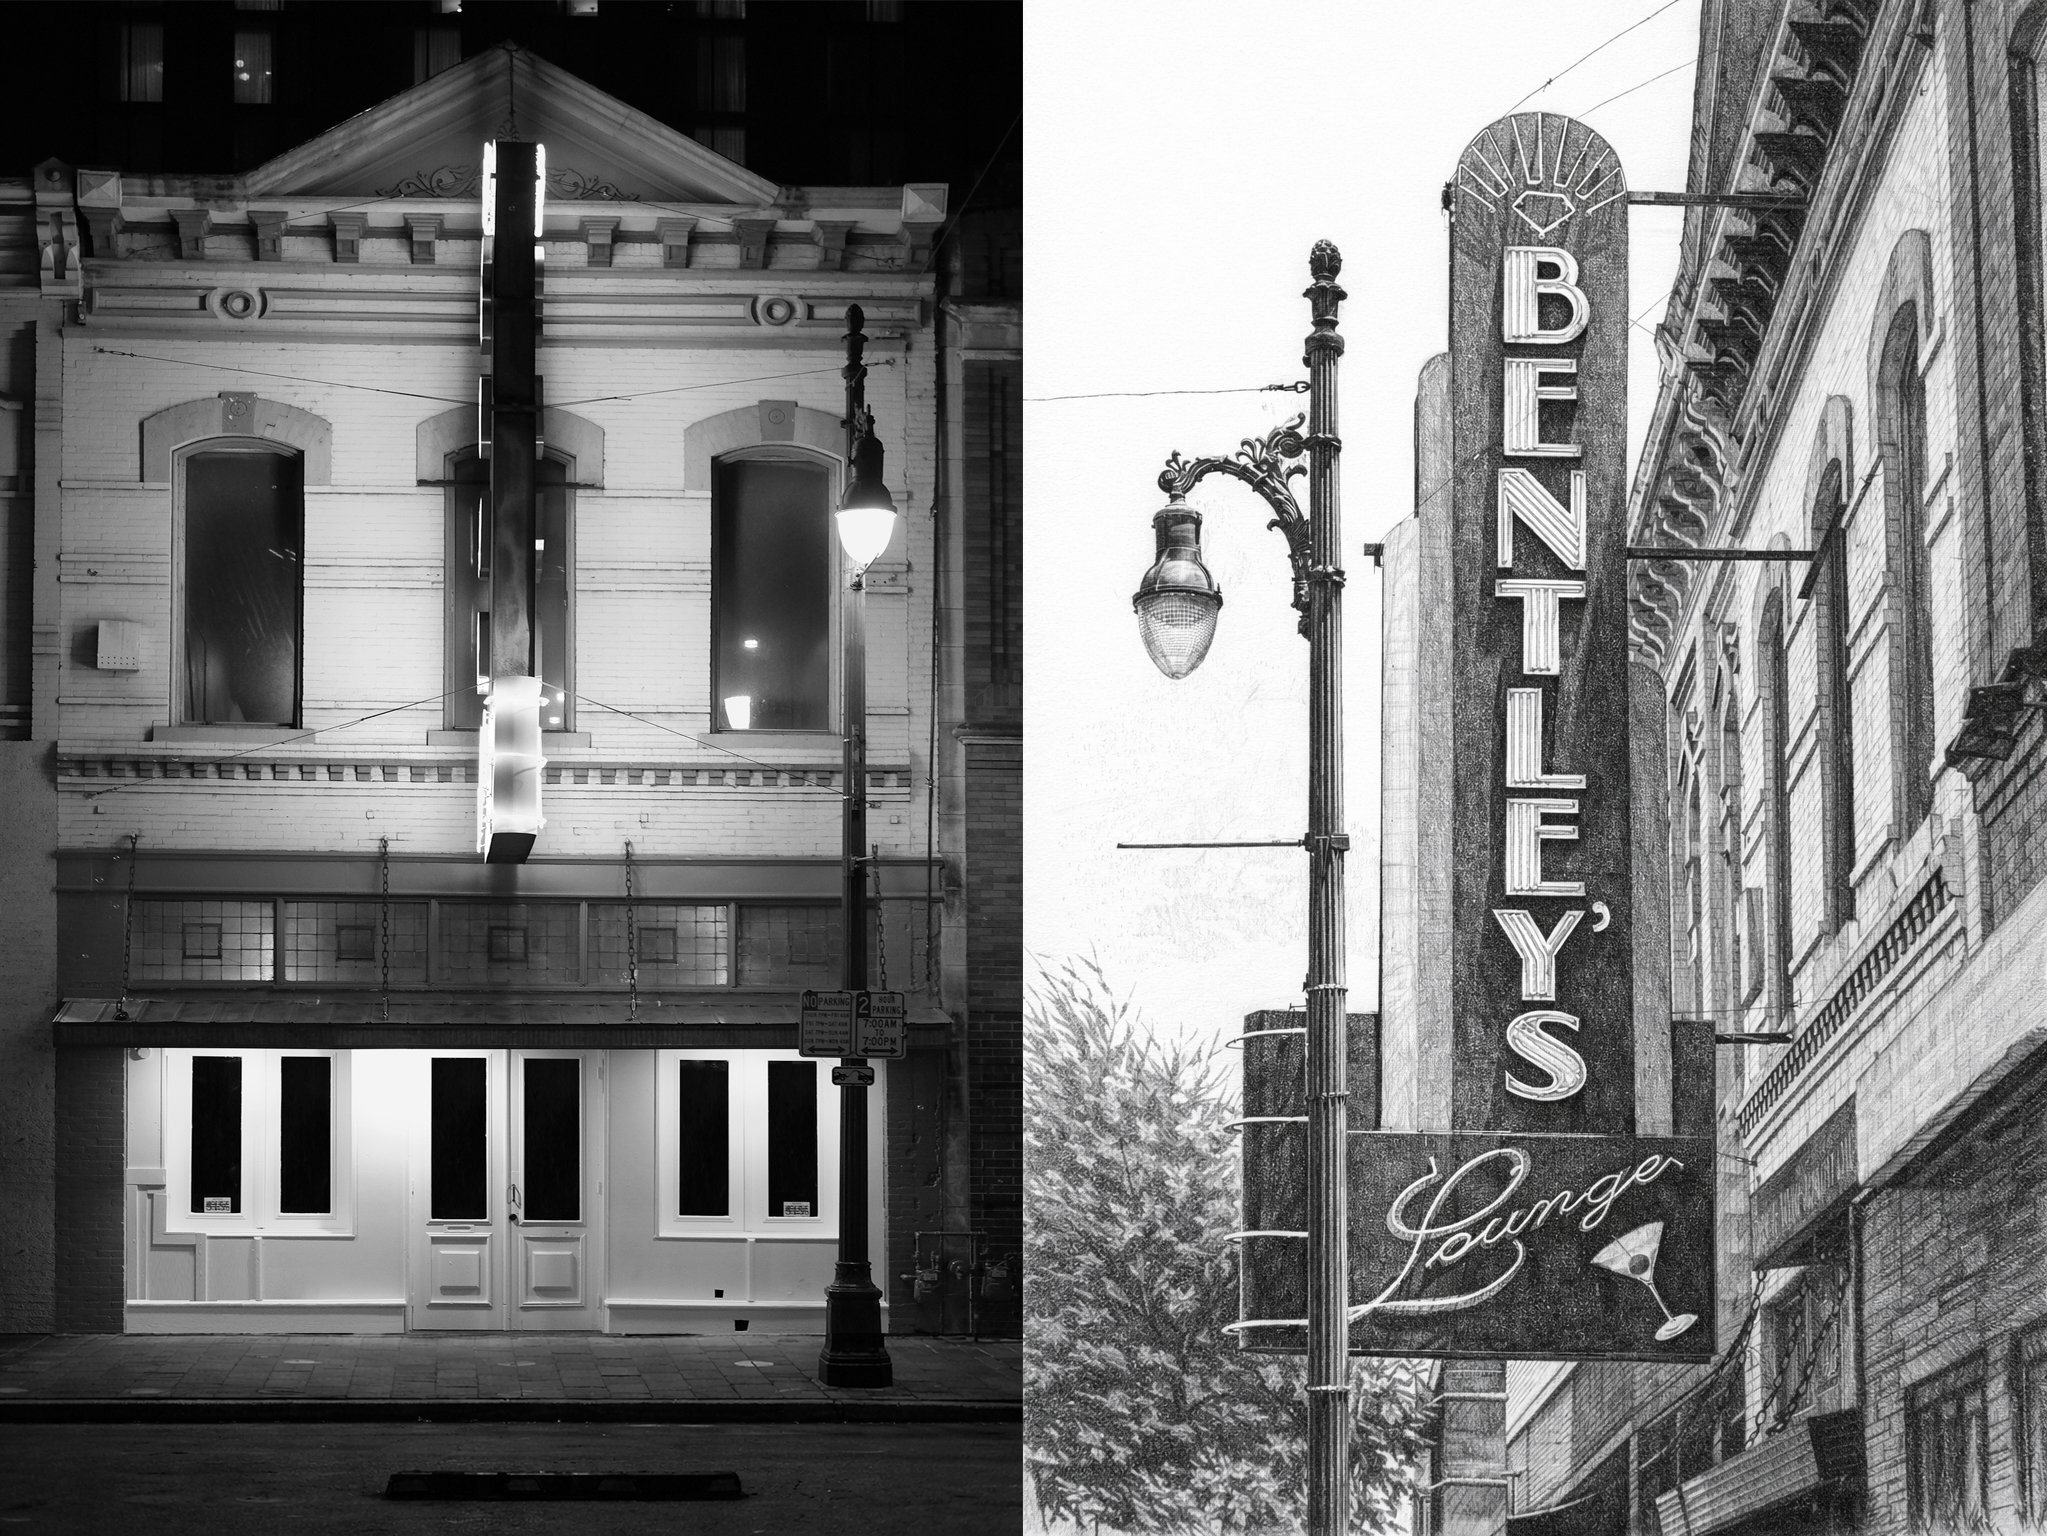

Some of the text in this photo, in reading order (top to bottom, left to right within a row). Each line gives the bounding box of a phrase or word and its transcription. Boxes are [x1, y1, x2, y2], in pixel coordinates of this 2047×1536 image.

[1493, 245, 1611, 1102] BENTLEY'S
[803, 995, 850, 1008] NO PARKING
[858, 996, 869, 1014] 2
[872, 1006, 901, 1014] PARKING
[863, 1019, 897, 1028] 7:00AM
[863, 1037, 897, 1046] 7:00PM
[1347, 1148, 1685, 1324] Lounge
